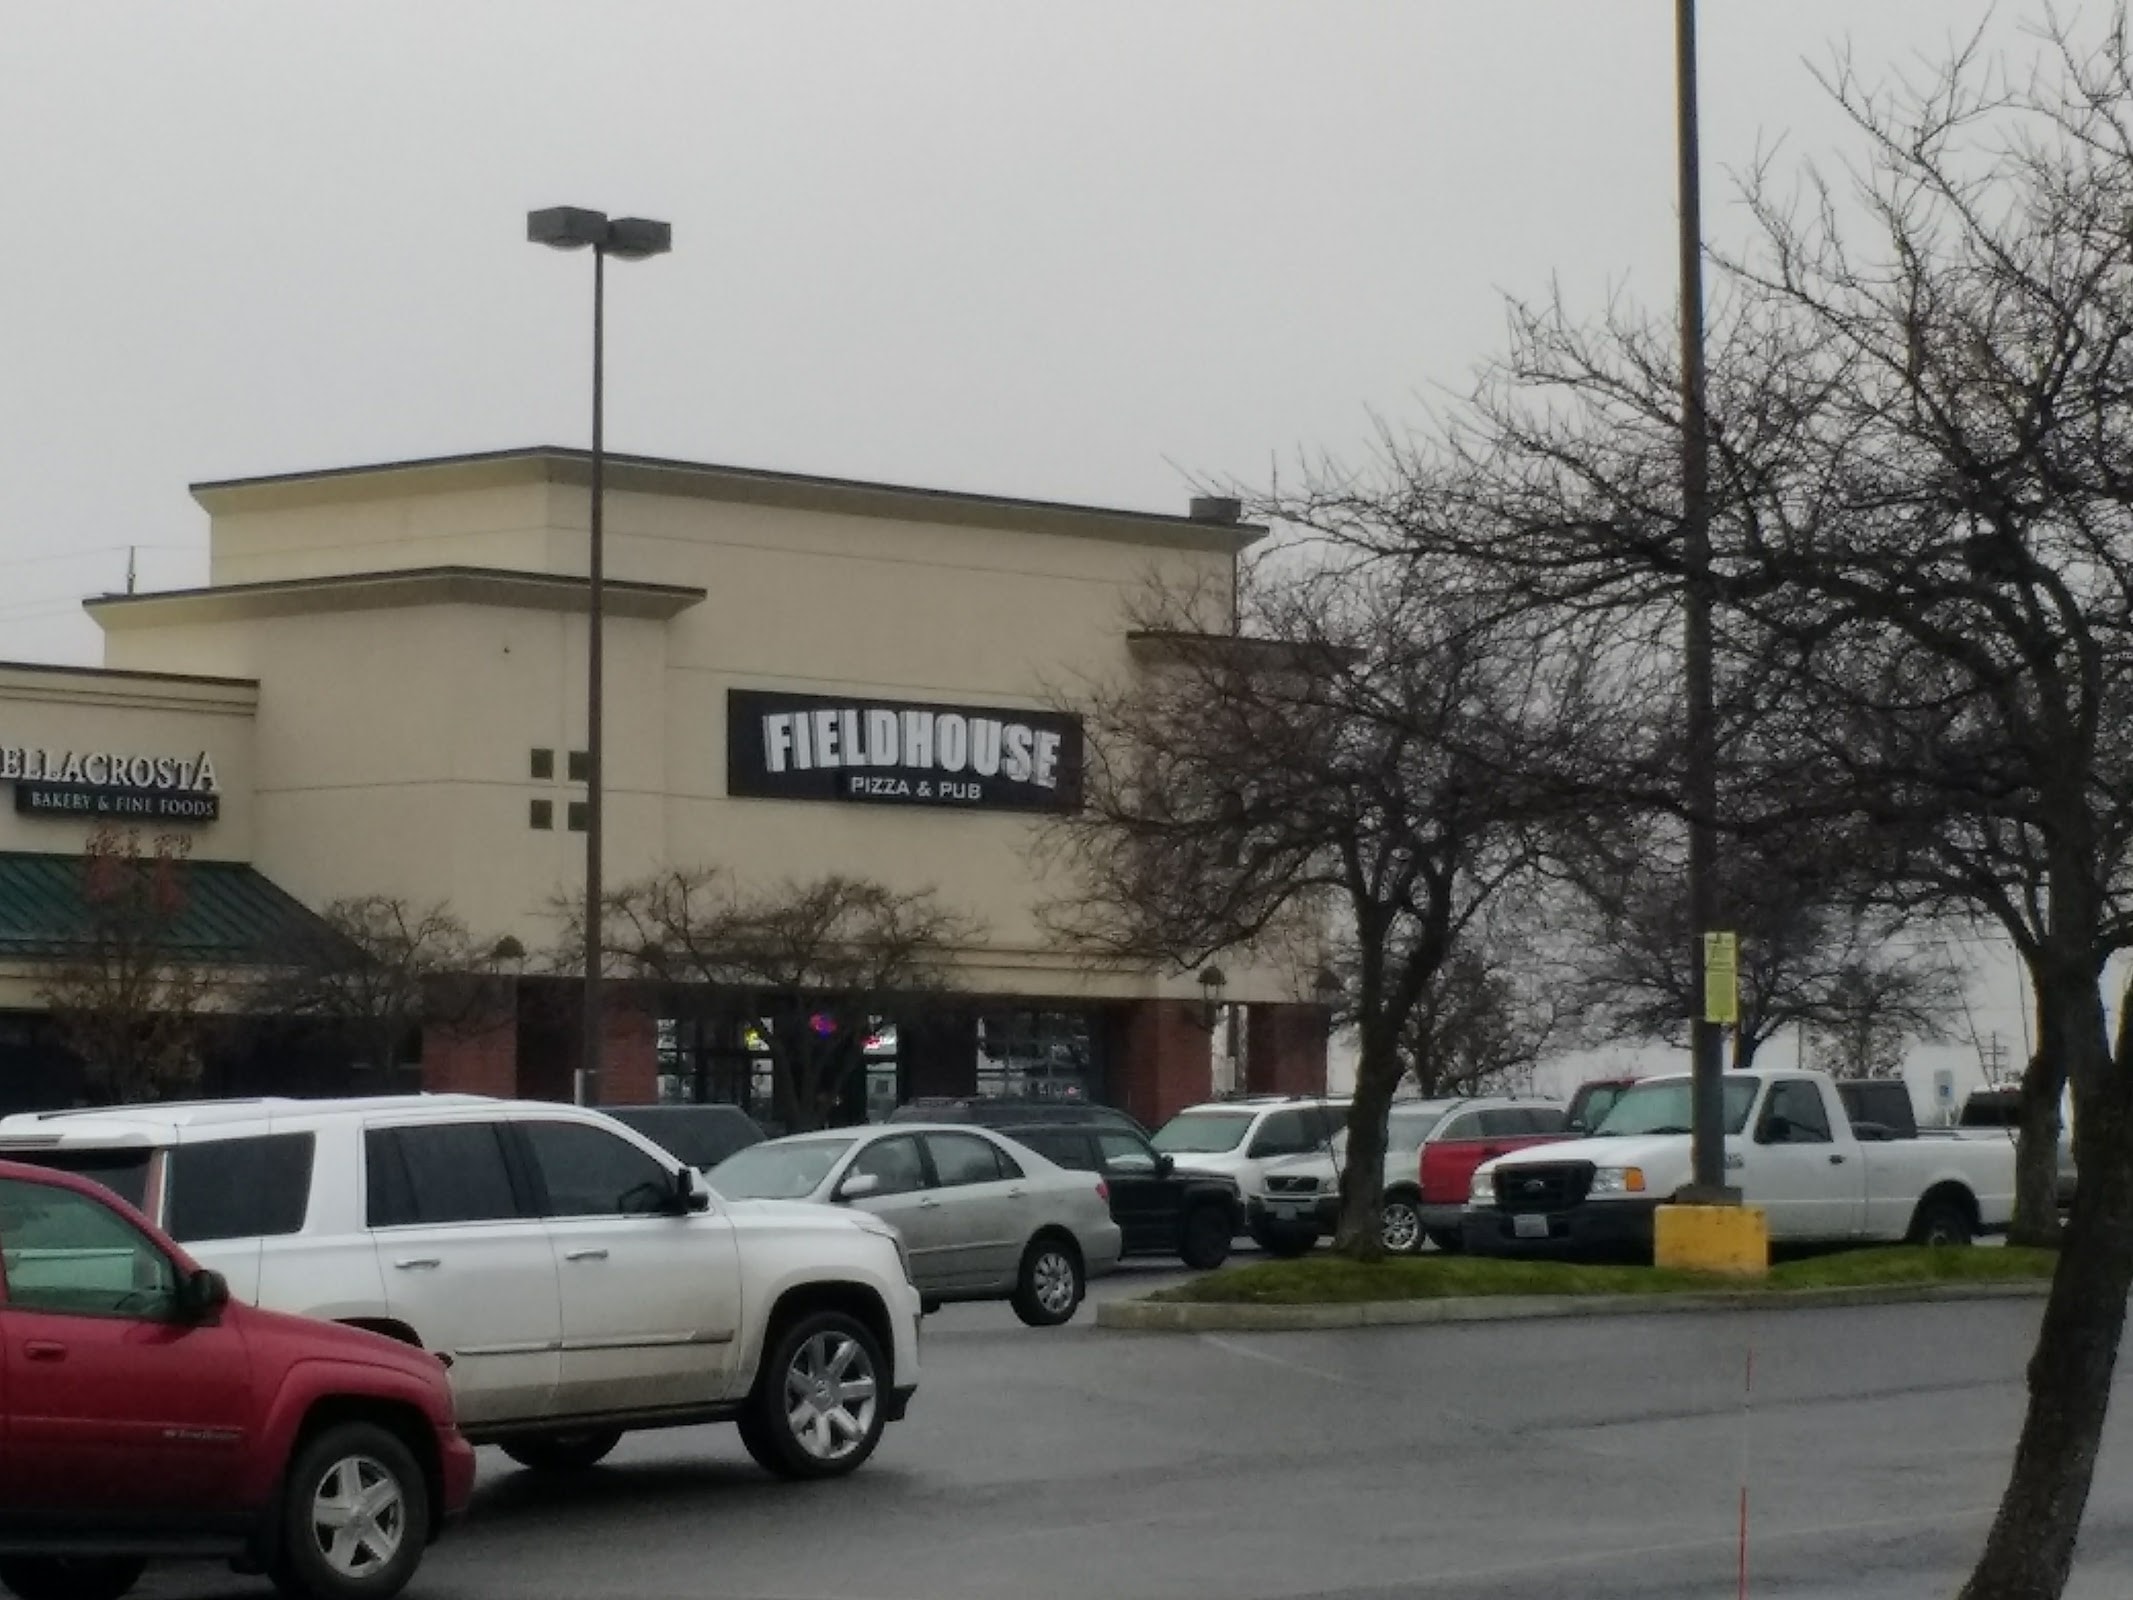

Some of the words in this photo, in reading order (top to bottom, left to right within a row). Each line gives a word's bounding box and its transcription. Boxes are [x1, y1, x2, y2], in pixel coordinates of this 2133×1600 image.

[762, 709, 1061, 788] FIELDHOUSE
[851, 776, 910, 796] PIZZA
[916, 780, 932, 797] &
[939, 781, 982, 800] PUB
[32, 791, 90, 809] BAKERY
[98, 795, 109, 811] &
[161, 798, 214, 815] FOODS
